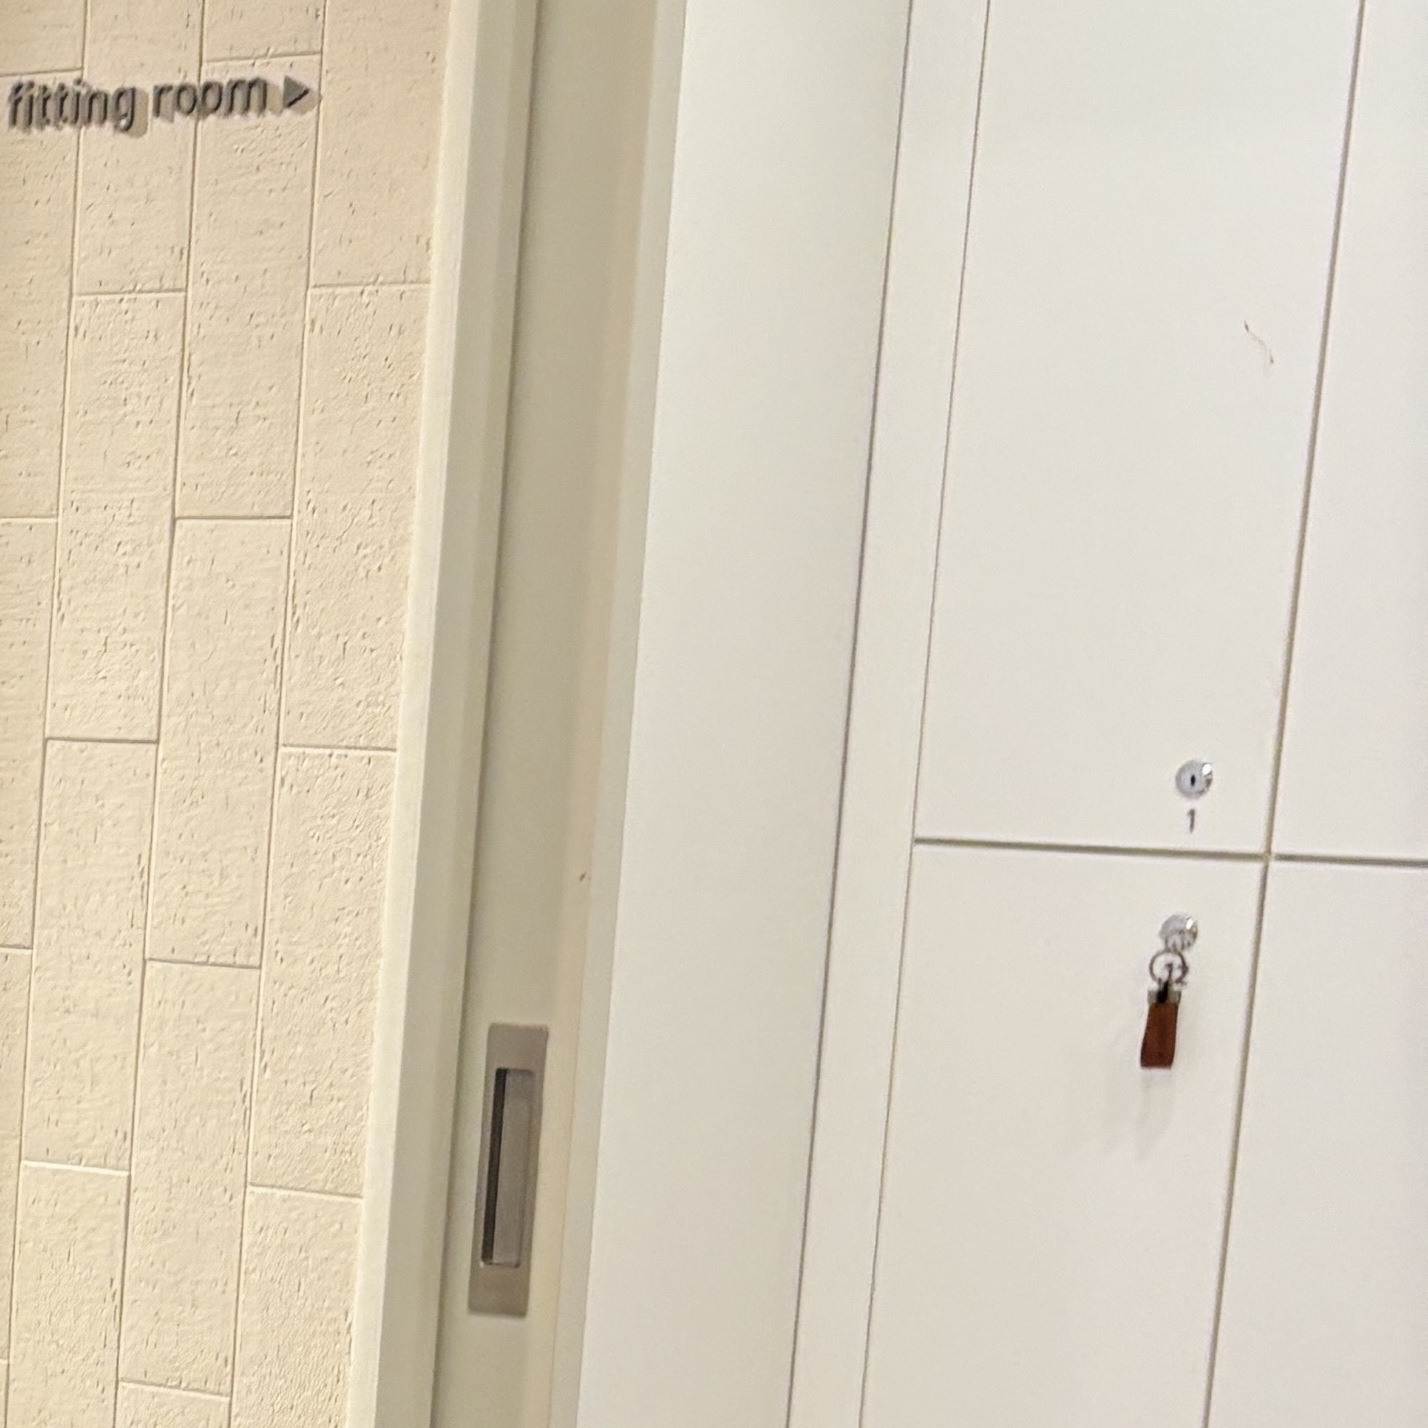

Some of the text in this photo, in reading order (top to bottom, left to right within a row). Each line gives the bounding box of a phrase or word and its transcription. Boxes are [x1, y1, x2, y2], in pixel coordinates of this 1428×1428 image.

[8, 76, 269, 132] fitting room
[1187, 808, 1195, 834] 1
